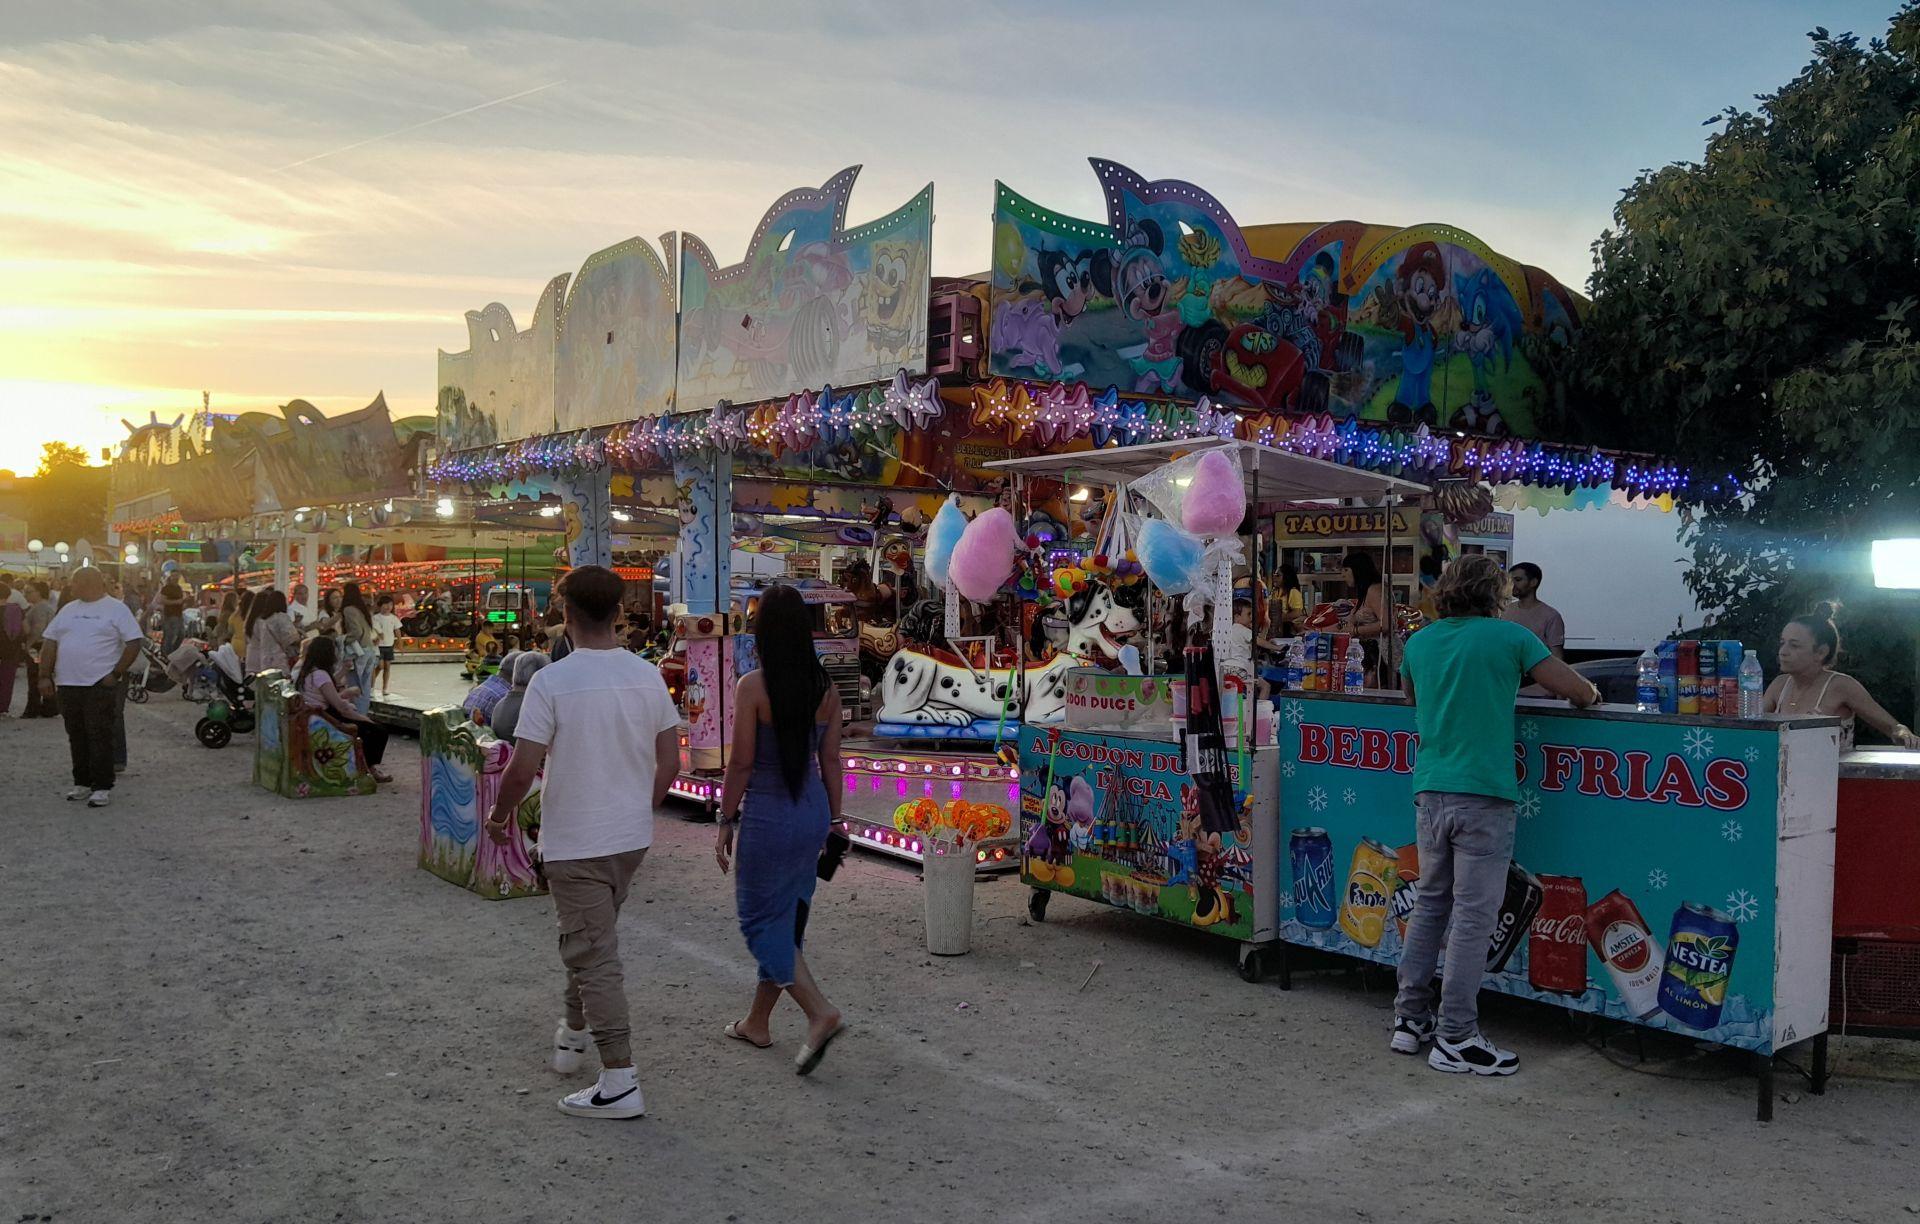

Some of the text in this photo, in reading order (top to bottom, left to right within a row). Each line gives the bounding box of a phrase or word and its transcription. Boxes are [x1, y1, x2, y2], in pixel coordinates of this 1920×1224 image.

[1285, 513, 1407, 536] TAQUILLA
[1459, 517, 1510, 535] AQUILLA
[1091, 697, 1135, 711] DULCE
[1032, 736, 1241, 786] ALGODON DUE
[1539, 744, 1749, 811] FRIAS
[1350, 882, 1386, 907] Fanta
[1530, 914, 1587, 945] oca-Cola
[1610, 931, 1640, 954] AMSTEL
[1671, 941, 1729, 977] NESTEA
[1675, 995, 1709, 1011] LIMÓN
